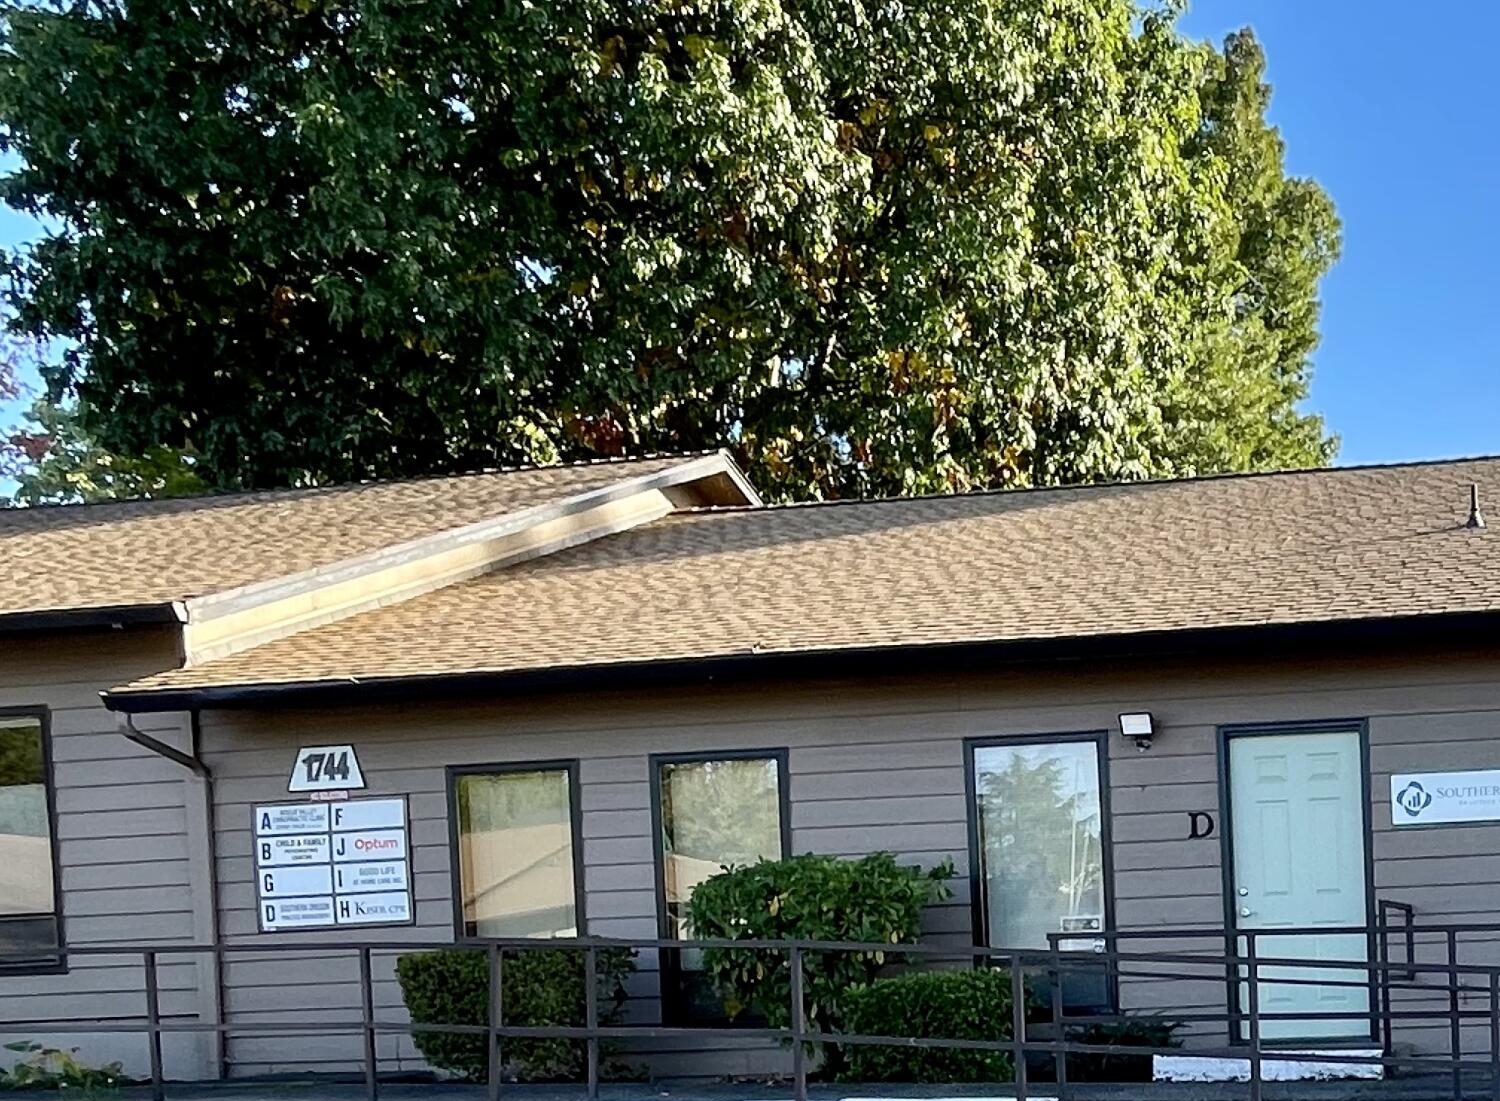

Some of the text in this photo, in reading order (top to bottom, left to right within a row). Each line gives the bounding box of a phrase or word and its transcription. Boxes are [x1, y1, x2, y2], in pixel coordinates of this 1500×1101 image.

[301, 751, 350, 782] 1744
[261, 812, 272, 830] A
[335, 808, 344, 826] F
[1187, 811, 1215, 840] D
[262, 843, 271, 860] B
[336, 838, 345, 856] J
[354, 838, 398, 853] Optum
[337, 870, 342, 887] I
[380, 866, 395, 875] LIFE
[264, 874, 274, 892] G
[266, 905, 275, 922] D
[340, 901, 350, 918] H
